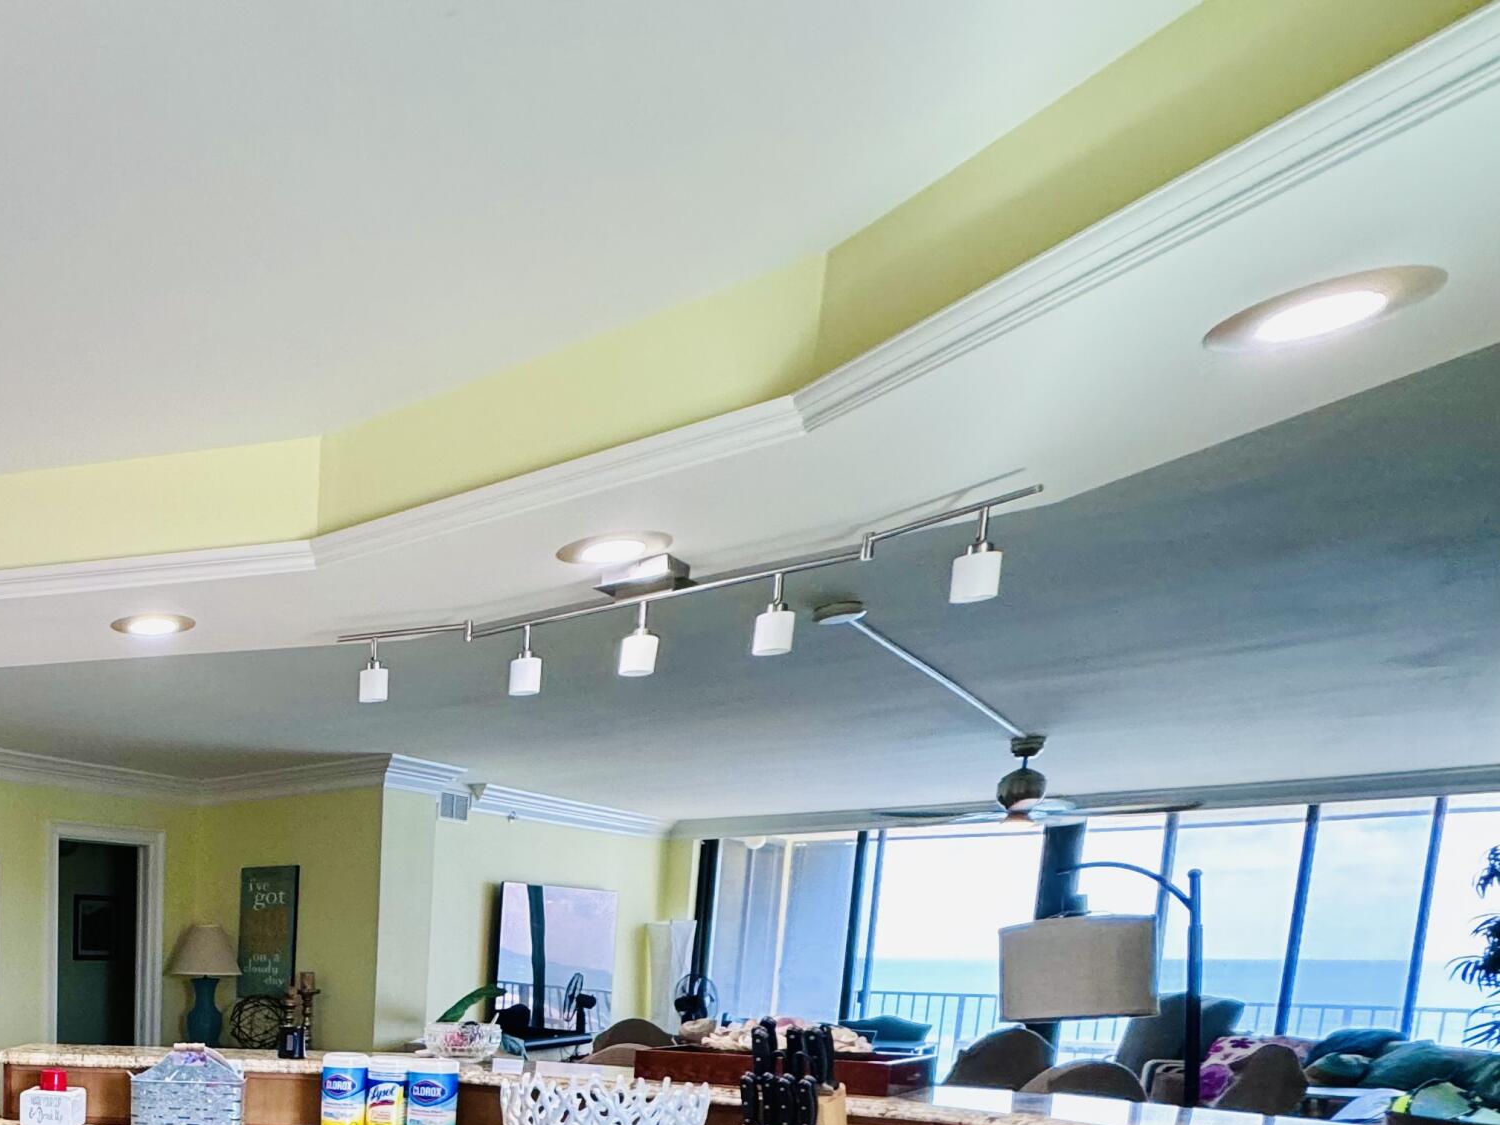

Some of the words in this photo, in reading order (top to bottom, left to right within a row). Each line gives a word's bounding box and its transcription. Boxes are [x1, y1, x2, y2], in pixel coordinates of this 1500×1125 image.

[248, 879, 270, 891] i've
[253, 891, 285, 911] got
[243, 959, 278, 975] cloudy
[264, 976, 284, 987] day
[325, 1080, 353, 1091] CLOROX
[412, 1086, 442, 1097] CLOROX
[371, 1086, 396, 1100] Lysol
